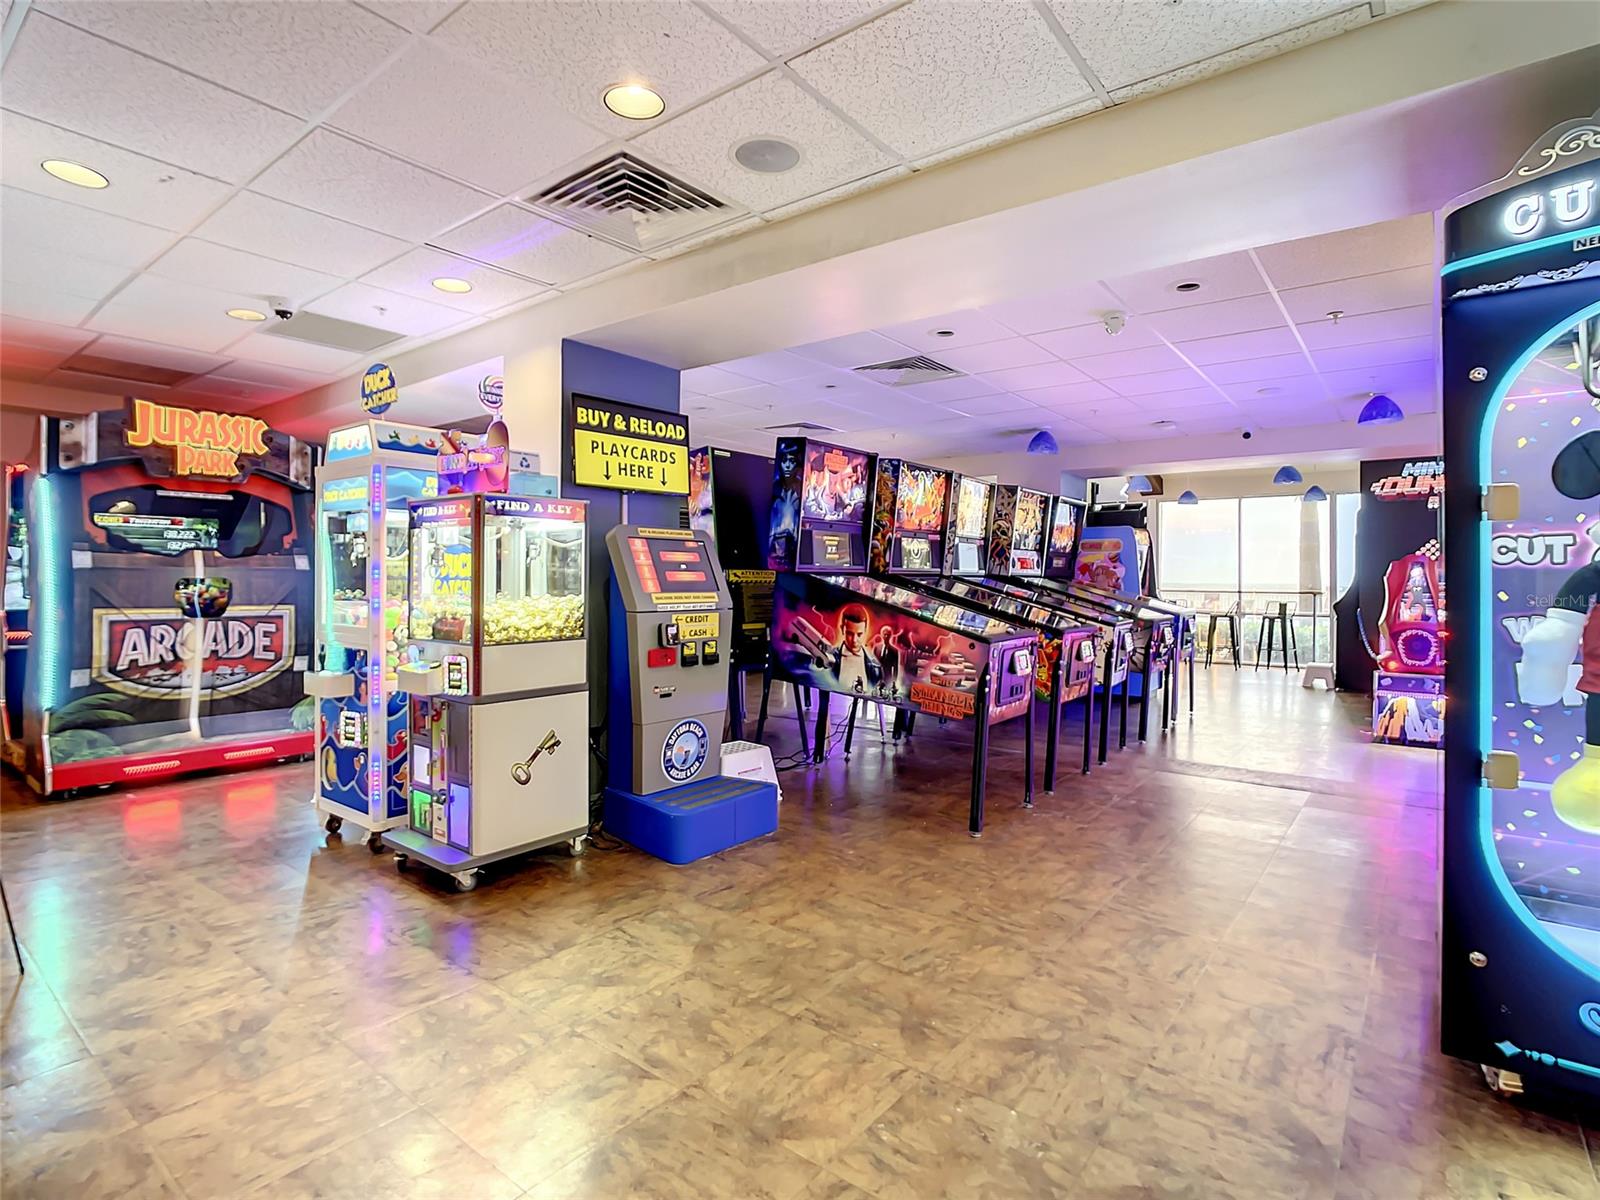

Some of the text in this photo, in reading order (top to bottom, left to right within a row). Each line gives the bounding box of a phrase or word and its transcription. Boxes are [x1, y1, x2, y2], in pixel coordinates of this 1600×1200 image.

[1576, 235, 1600, 249] NE
[364, 366, 391, 394] DUCK
[362, 387, 398, 412] CATCHER
[127, 399, 270, 456] JURASSIC
[576, 407, 686, 441] BUY & RELOAD
[177, 444, 240, 476] PARK
[591, 440, 676, 465] PLAYCARDS
[618, 462, 654, 479] HERE
[496, 499, 573, 515] FIND A KEY
[1492, 534, 1576, 565] CUT
[684, 615, 709, 624] CREDIT
[116, 620, 277, 671] ARCADE
[688, 629, 707, 637] CASH
[912, 686, 974, 711] STRANGER
[921, 699, 964, 718] THINGS
